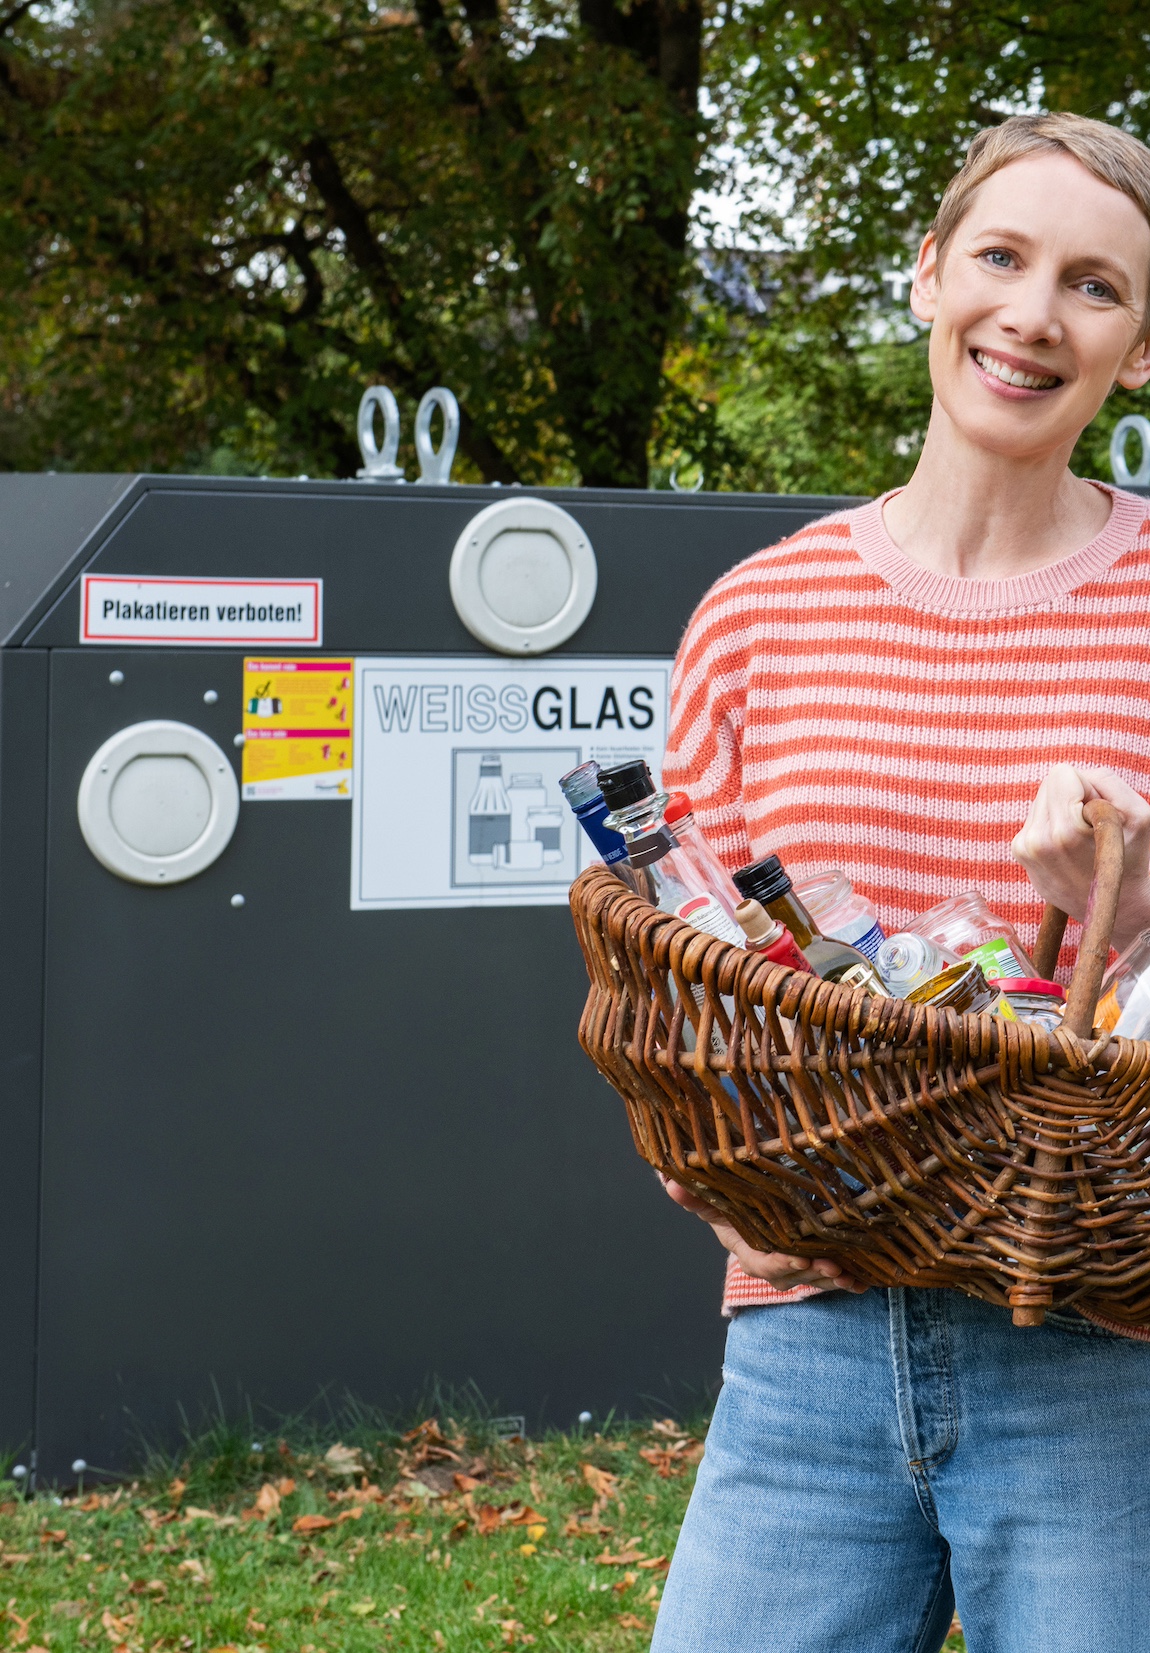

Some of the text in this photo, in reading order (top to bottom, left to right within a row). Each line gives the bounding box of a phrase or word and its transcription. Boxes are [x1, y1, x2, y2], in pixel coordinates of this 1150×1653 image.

[102, 599, 302, 623] Plakatieren verboten!
[373, 683, 655, 734] WEISSGLAS
